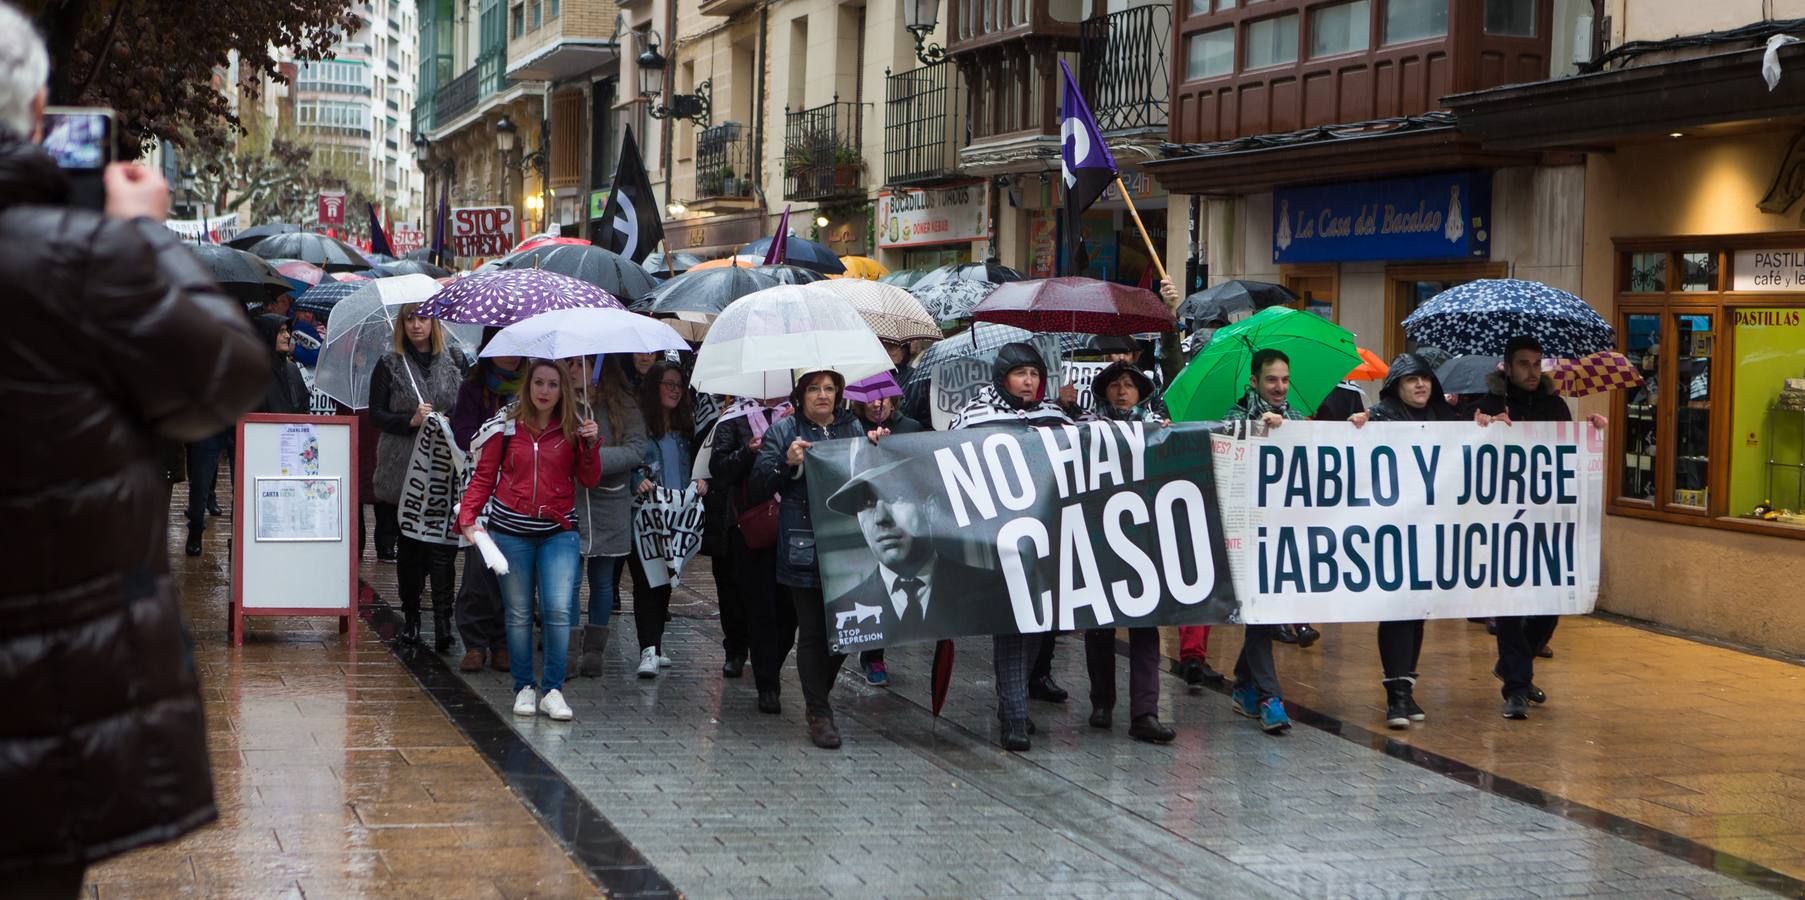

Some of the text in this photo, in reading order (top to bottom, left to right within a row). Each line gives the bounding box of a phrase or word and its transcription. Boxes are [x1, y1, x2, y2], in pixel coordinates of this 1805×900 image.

[890, 189, 935, 213] BOCADILLOS
[456, 208, 511, 235] STOP
[1295, 200, 1442, 239] La Casa del Bacalao
[1755, 252, 1805, 268] PASTIL
[1754, 270, 1782, 285] café
[1785, 277, 1791, 288] y
[1735, 311, 1800, 327] PASTILLAS
[934, 433, 1037, 528] NO
[1038, 420, 1145, 499] HAY
[1258, 445, 1400, 507] PABLO
[1411, 445, 1441, 505] Y
[1457, 444, 1577, 505] JORGE
[400, 477, 425, 534] PABLO
[413, 460, 429, 474] Y
[996, 479, 1215, 634] CASO
[1258, 509, 1576, 594] ¡ABSOLUCIÓN!
[839, 628, 860, 638] STOP
